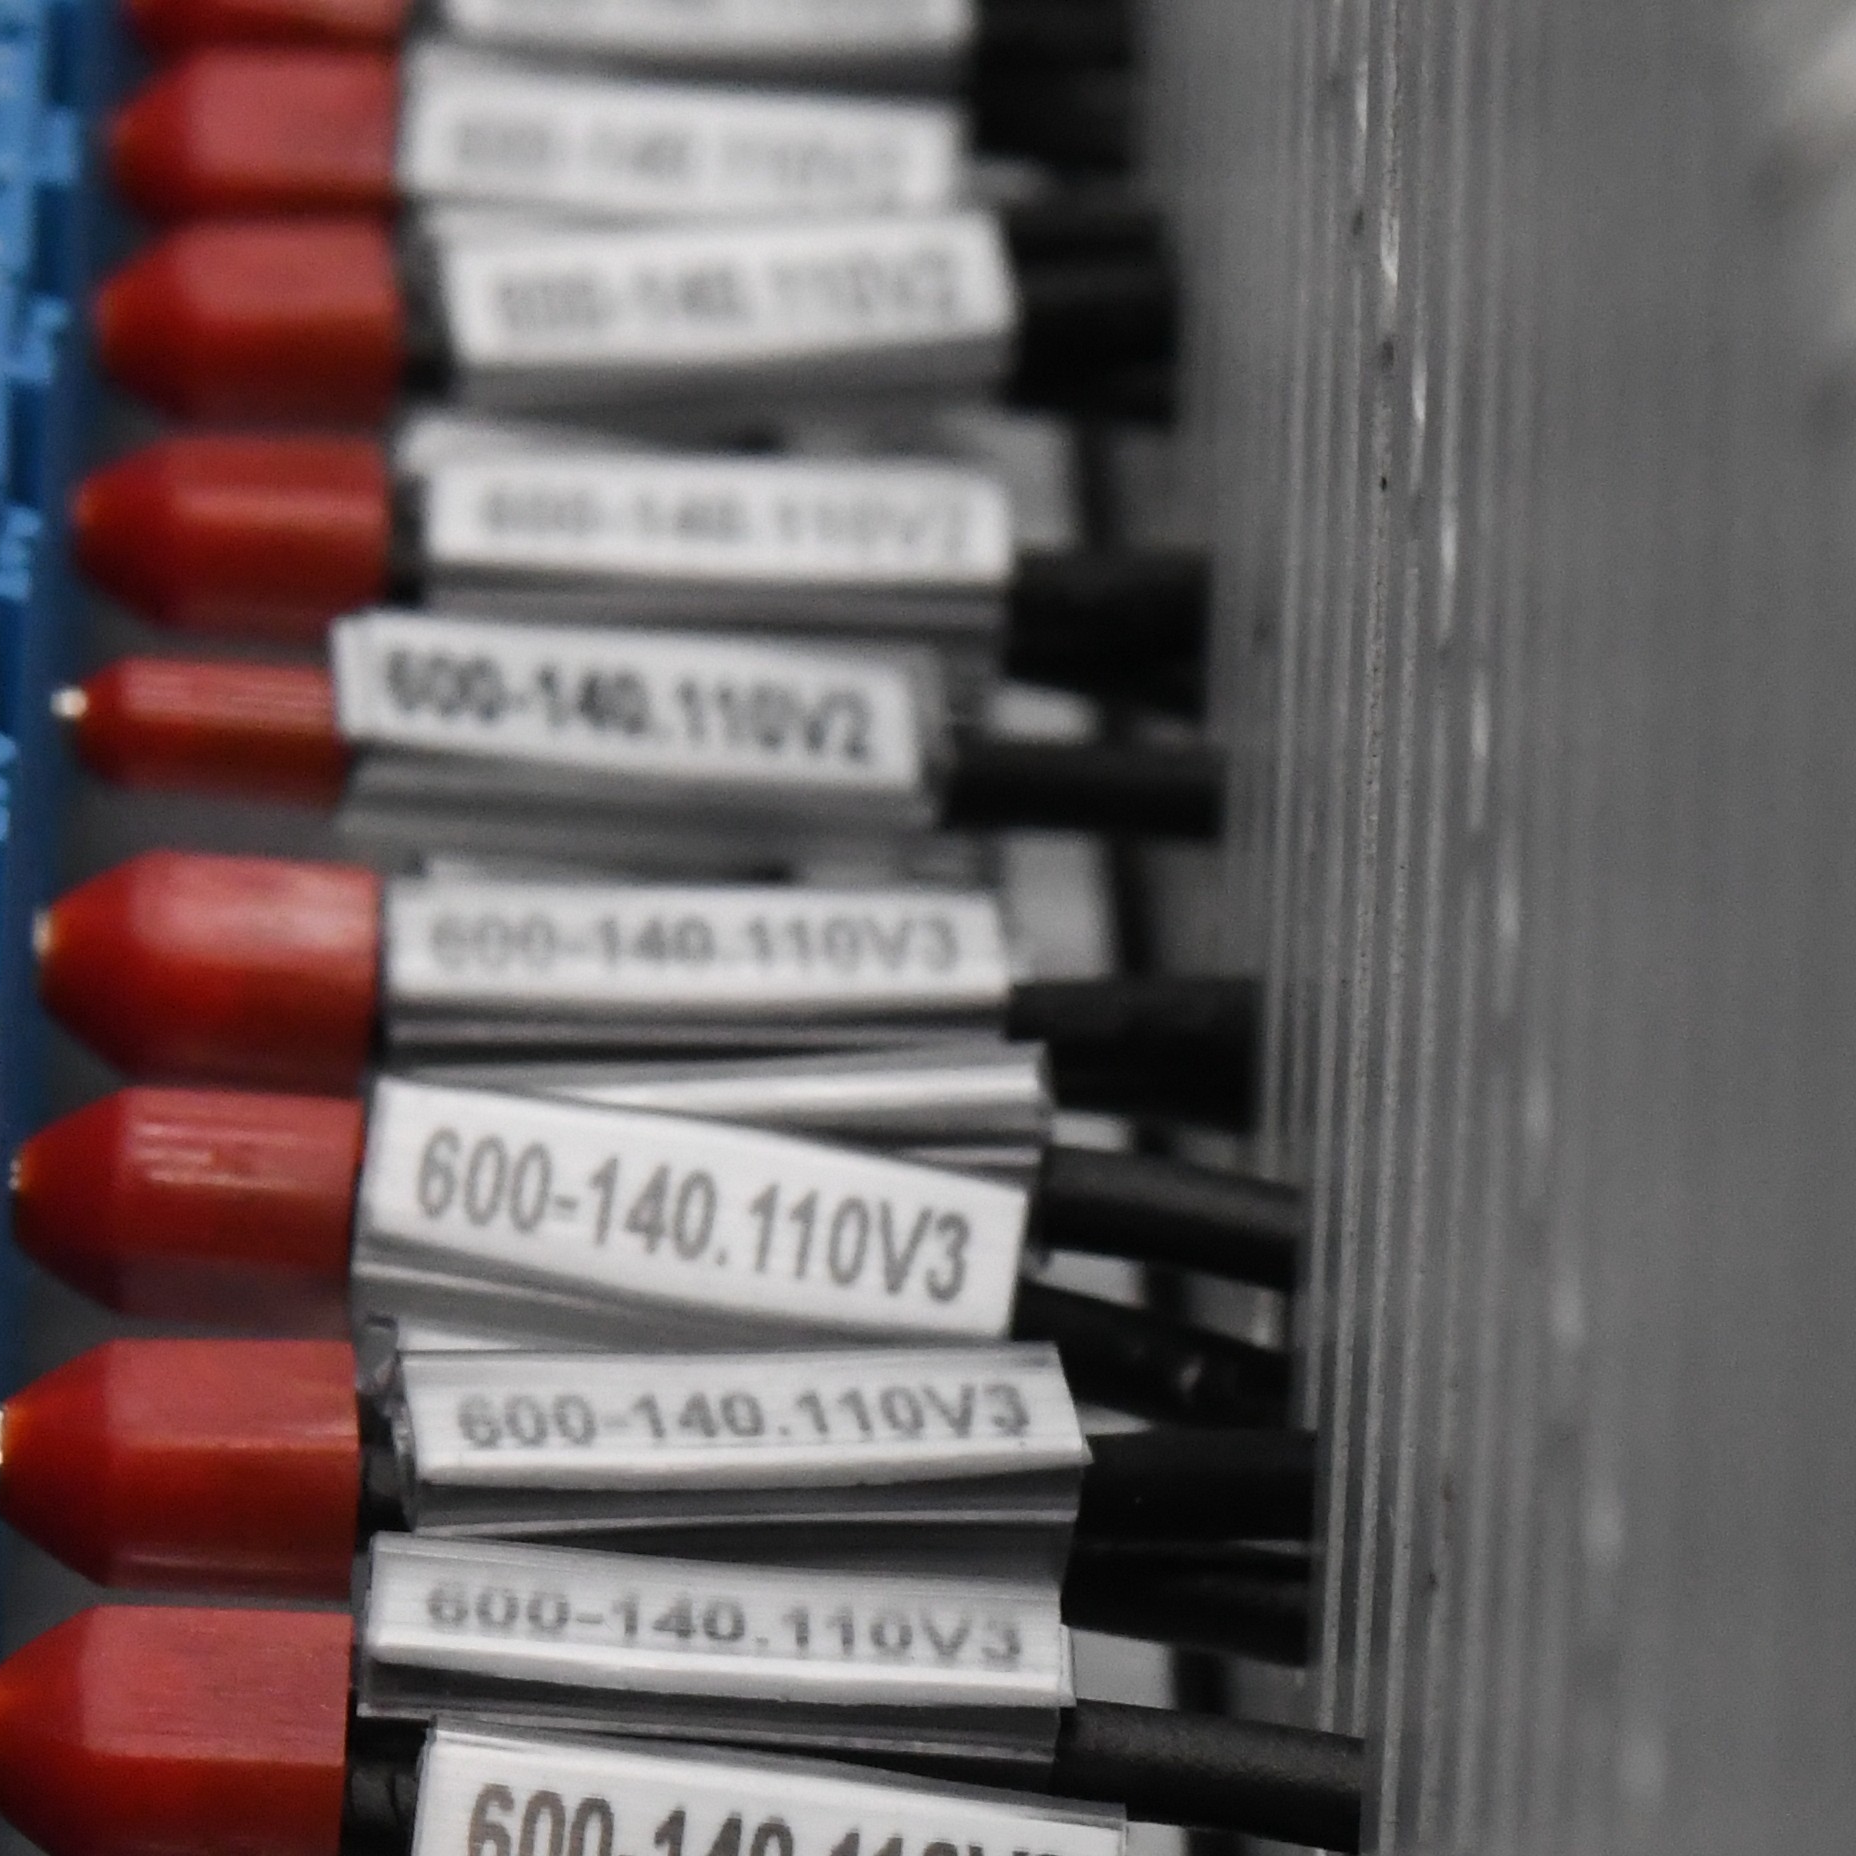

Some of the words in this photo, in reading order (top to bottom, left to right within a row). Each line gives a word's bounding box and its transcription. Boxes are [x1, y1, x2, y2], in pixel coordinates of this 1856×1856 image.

[384, 636, 876, 766] 600-140.110V2
[429, 893, 966, 973] 600-140.110V3
[415, 1126, 972, 1306] 600-140.110V3
[458, 1380, 1032, 1452] 600-140.110V3
[426, 1574, 1024, 1666] 600-140.110V3
